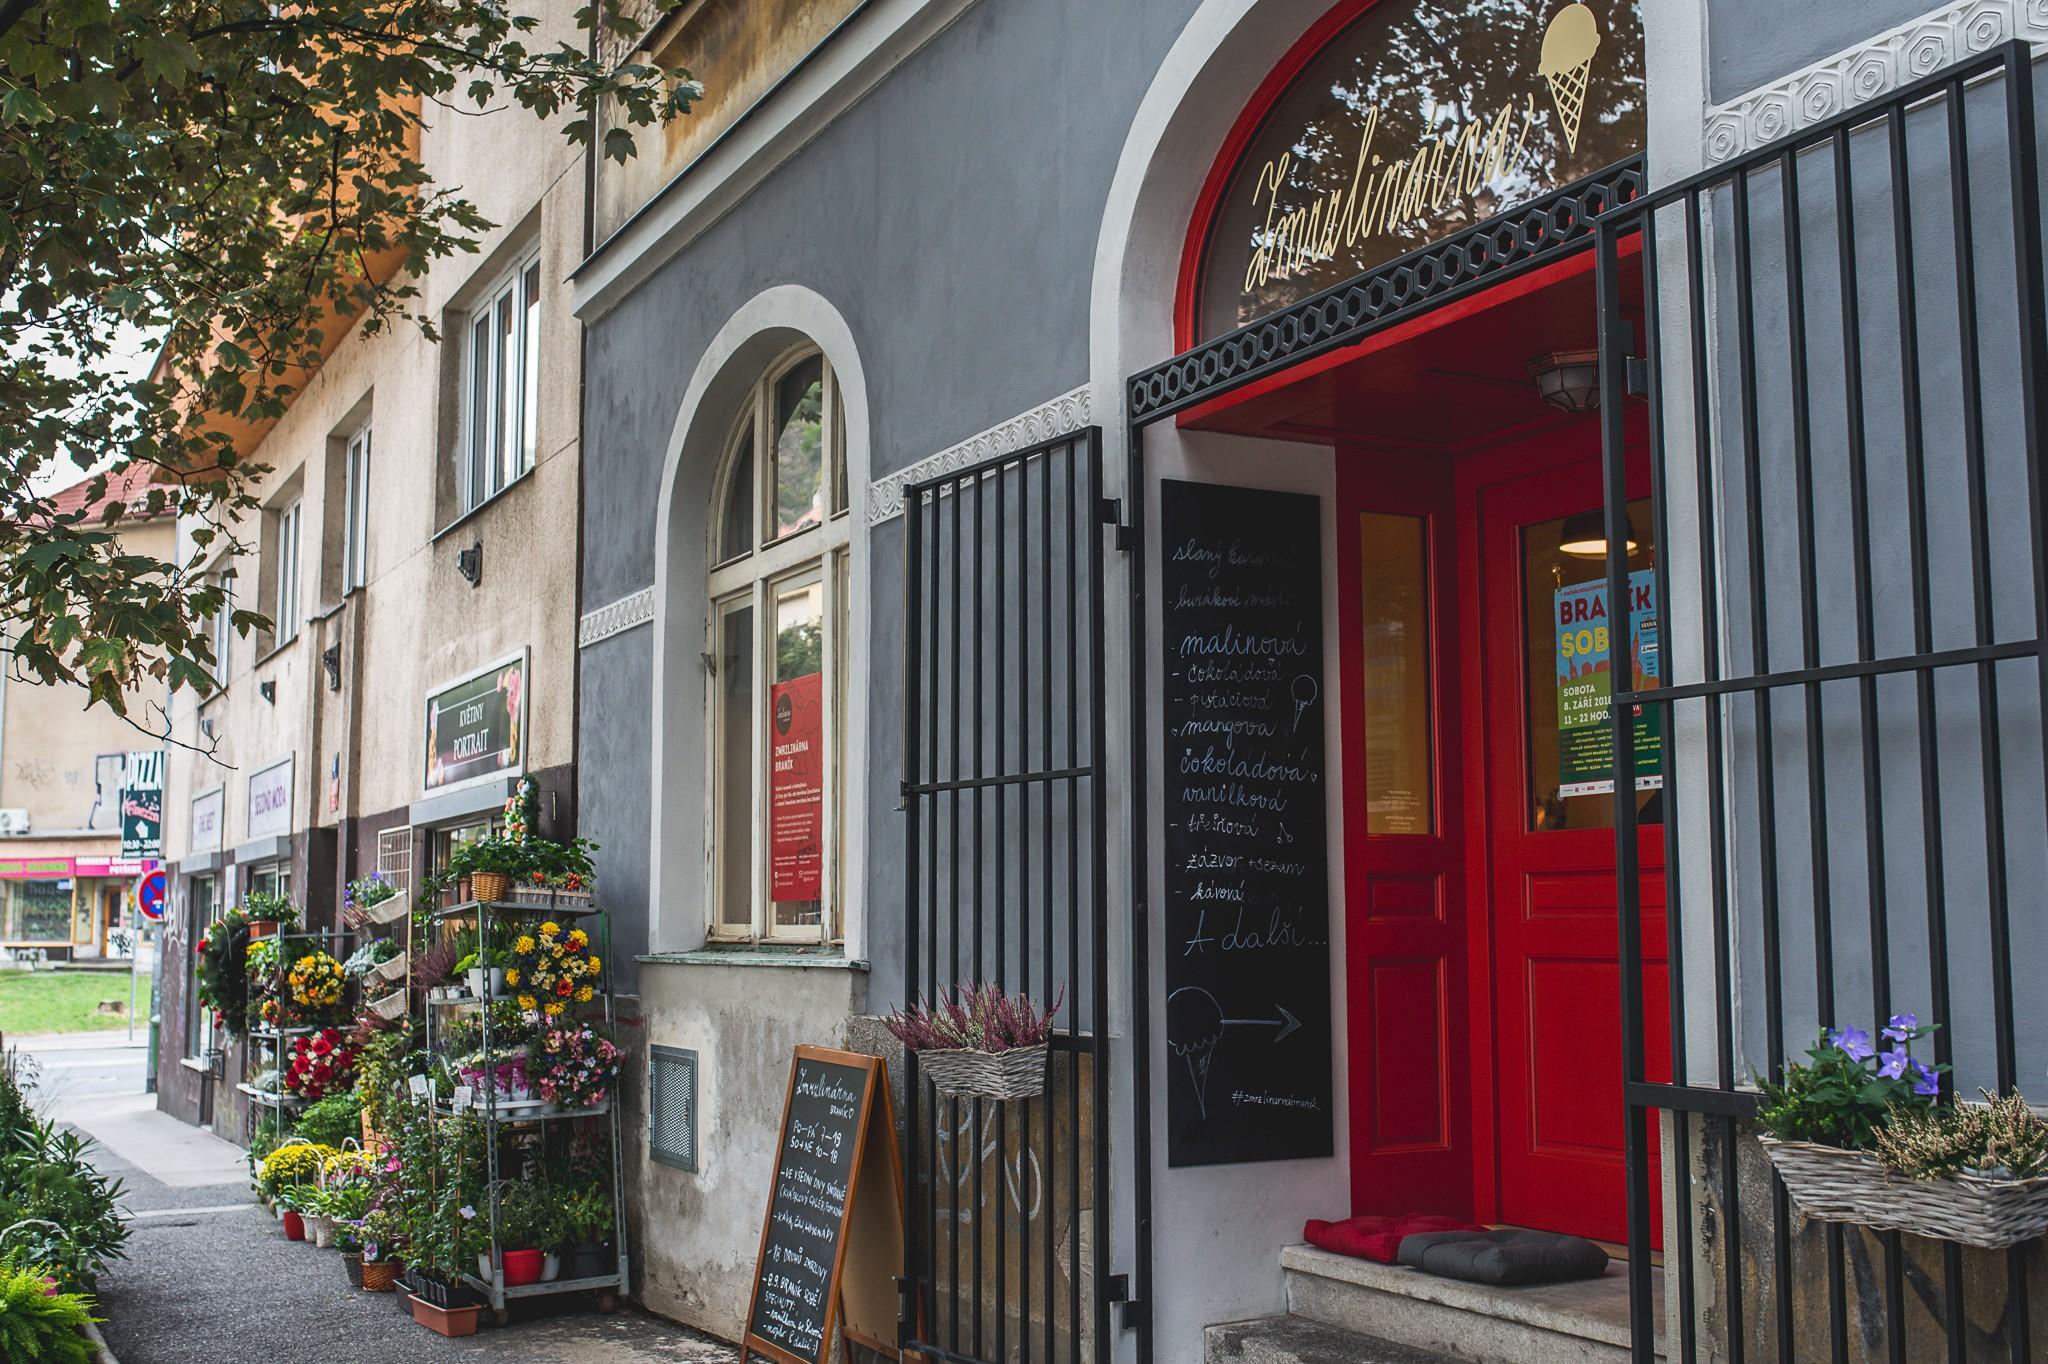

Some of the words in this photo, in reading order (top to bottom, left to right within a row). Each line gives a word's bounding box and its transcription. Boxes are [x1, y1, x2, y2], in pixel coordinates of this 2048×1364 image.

[1563, 684, 1595, 697] SOBOTA
[1573, 696, 1592, 710] ZÁŘÍ
[459, 702, 484, 727] KVĚTINY
[1564, 715, 1572, 725] 11
[1579, 713, 1588, 722] 22
[1590, 711, 1611, 722] HOD.
[453, 728, 489, 760] PORTRAIT
[127, 752, 162, 791] PIZZA
